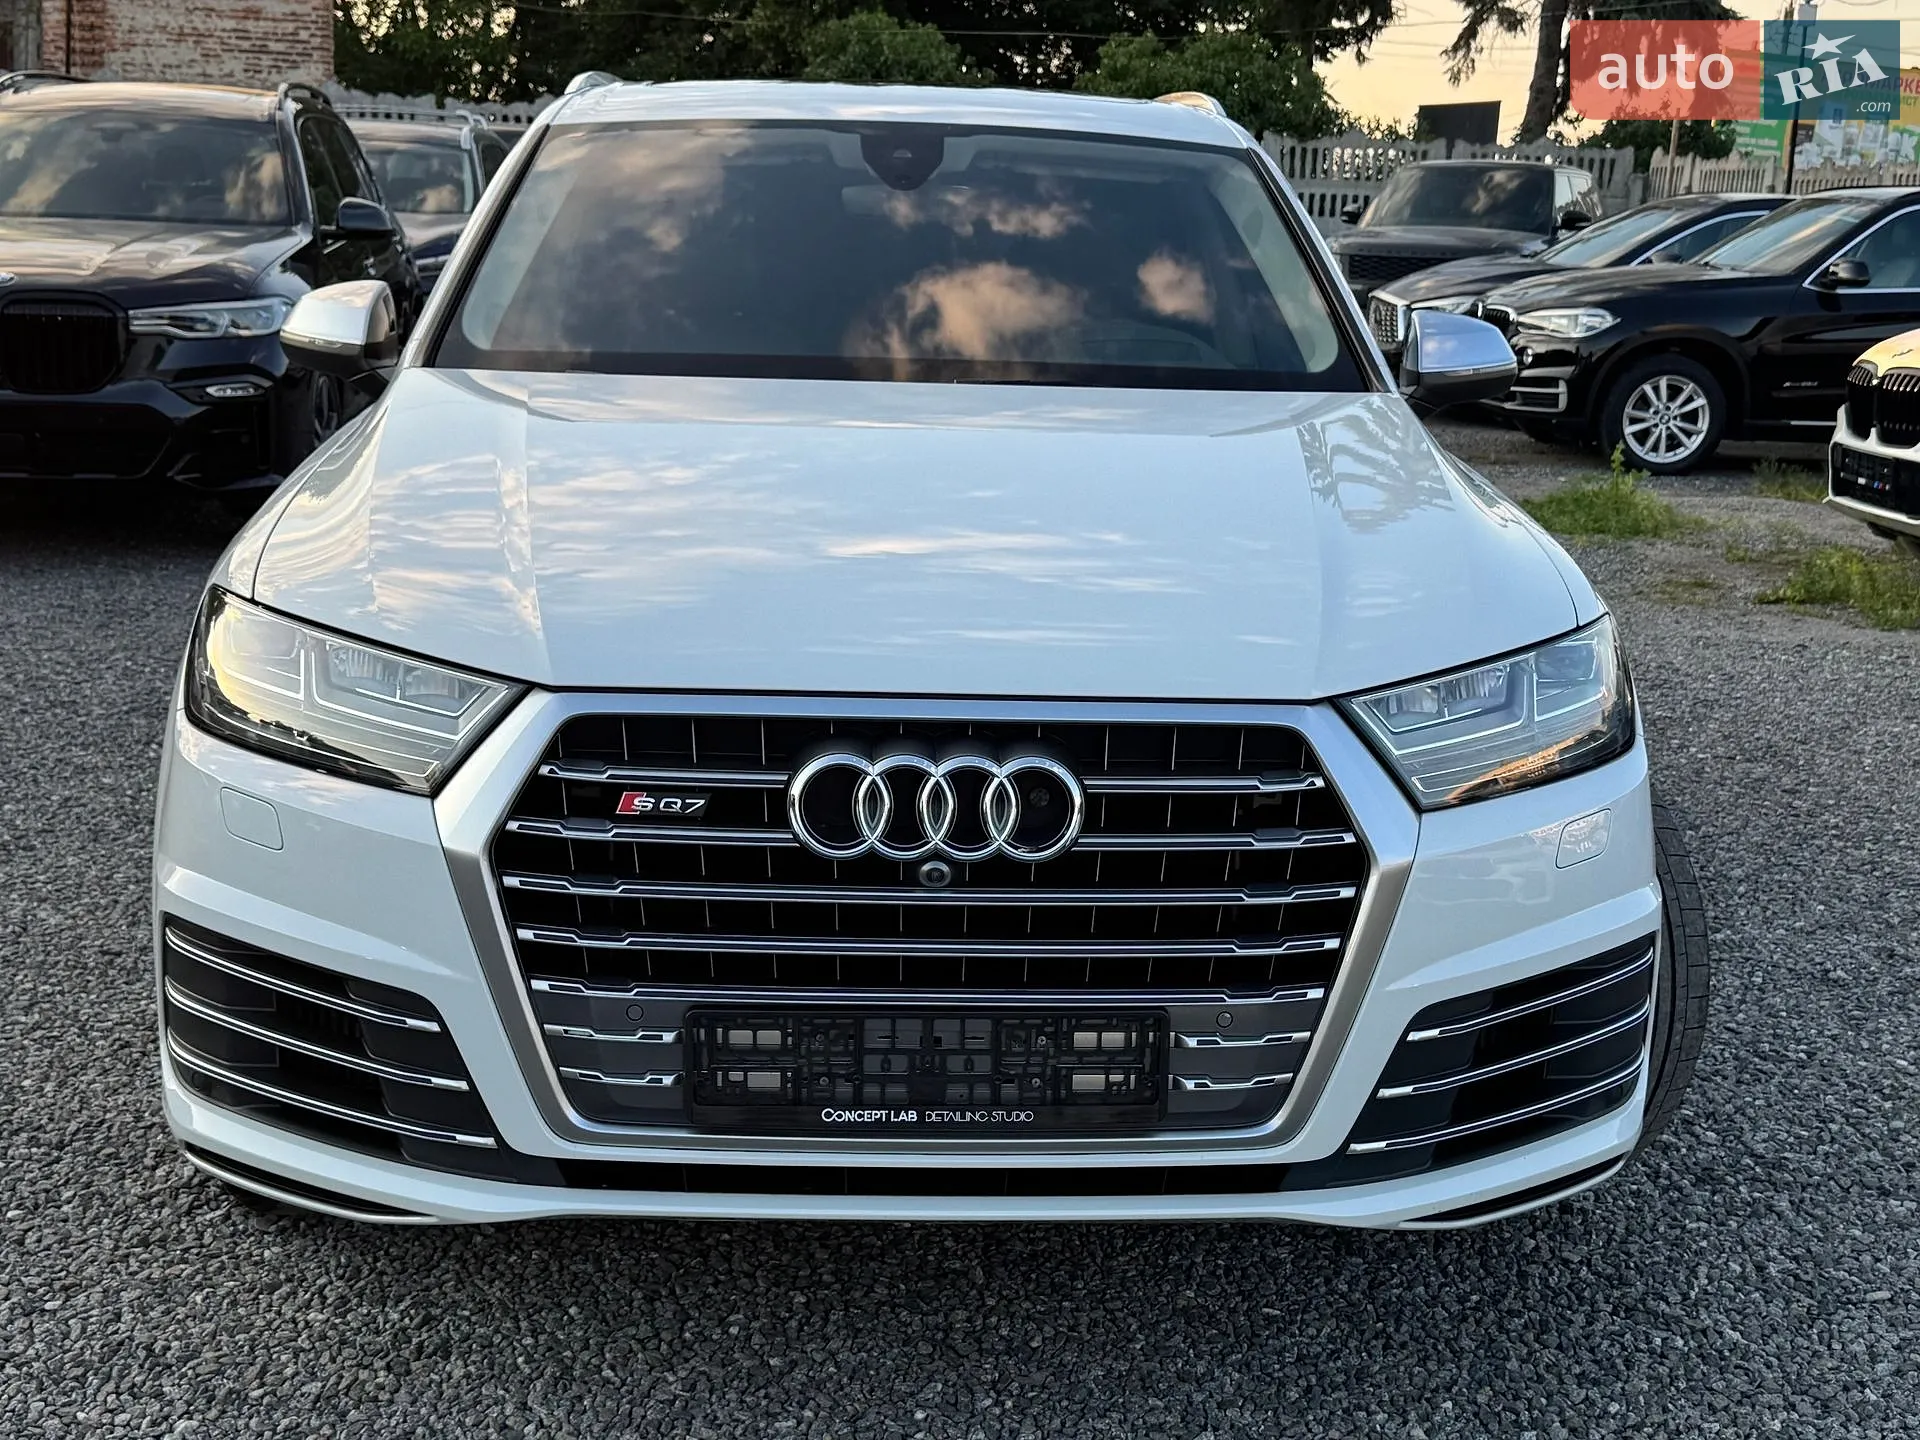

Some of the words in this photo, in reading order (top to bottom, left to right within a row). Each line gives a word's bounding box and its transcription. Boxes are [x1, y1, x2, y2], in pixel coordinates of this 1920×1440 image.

[630, 797, 706, 814] SQ7
[821, 1108, 888, 1122] CONCEPT
[890, 1110, 918, 1122] LAB
[990, 1110, 1034, 1122] STUDIO
